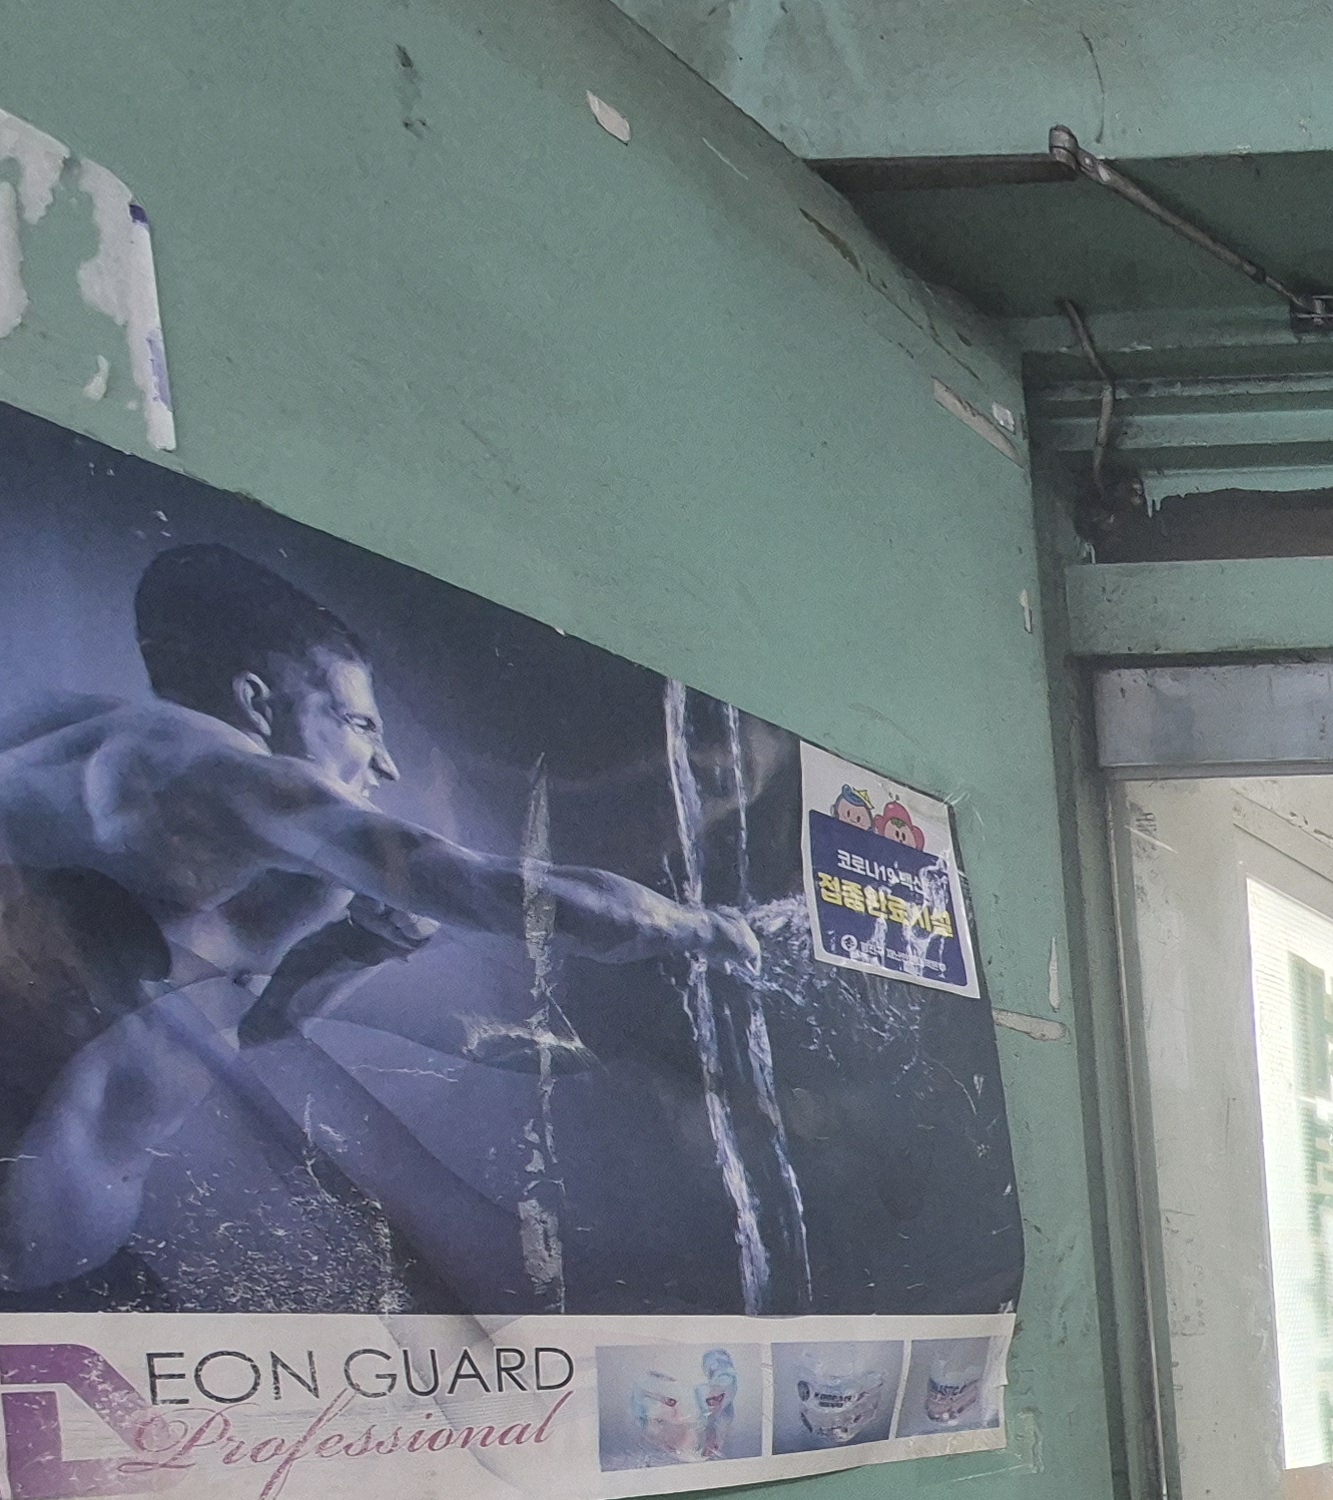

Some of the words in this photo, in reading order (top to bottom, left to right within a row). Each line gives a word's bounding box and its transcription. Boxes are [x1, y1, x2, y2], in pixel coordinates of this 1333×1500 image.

[837, 849, 900, 884] 코로나19
[145, 1349, 322, 1406] EON
[342, 1346, 575, 1399] GUARD
